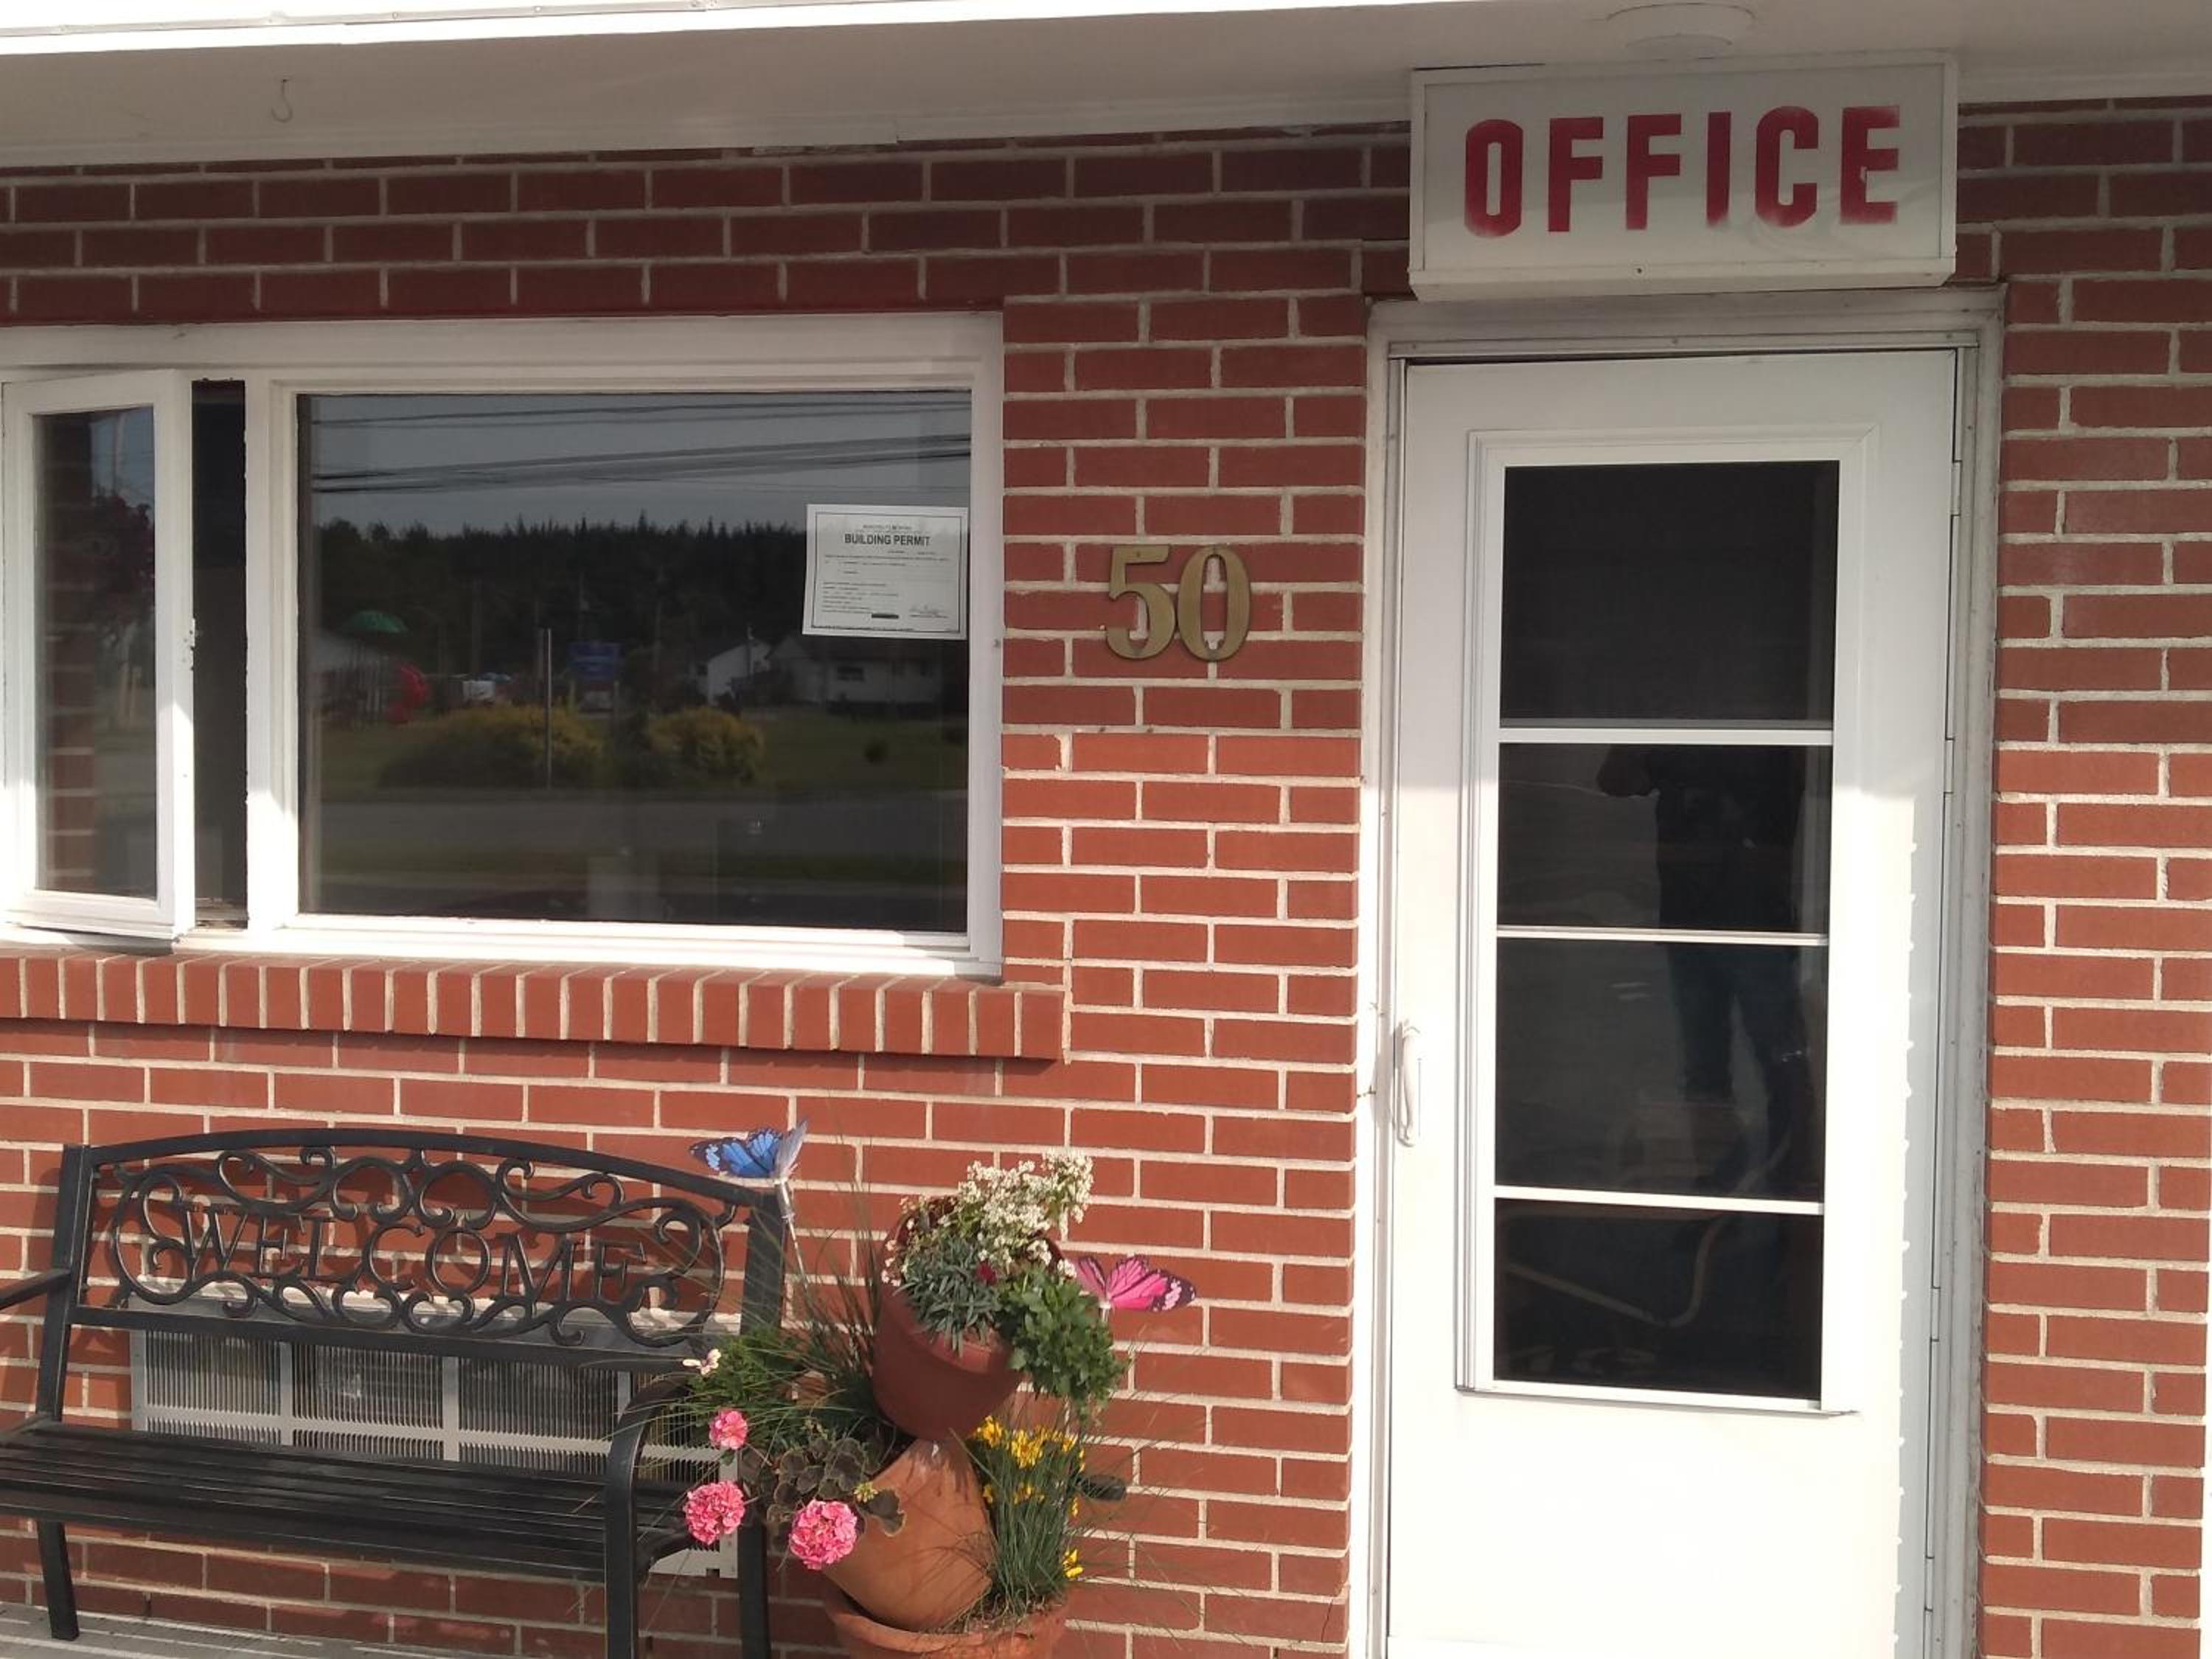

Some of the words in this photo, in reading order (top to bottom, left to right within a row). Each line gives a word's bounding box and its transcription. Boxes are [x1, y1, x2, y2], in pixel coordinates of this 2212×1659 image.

[1464, 105, 1900, 237] OFFICE
[844, 533, 891, 545] BUILDING
[894, 535, 931, 546] PERMIT
[1106, 544, 1251, 661] 50
[177, 1205, 649, 1305] WELCOME
